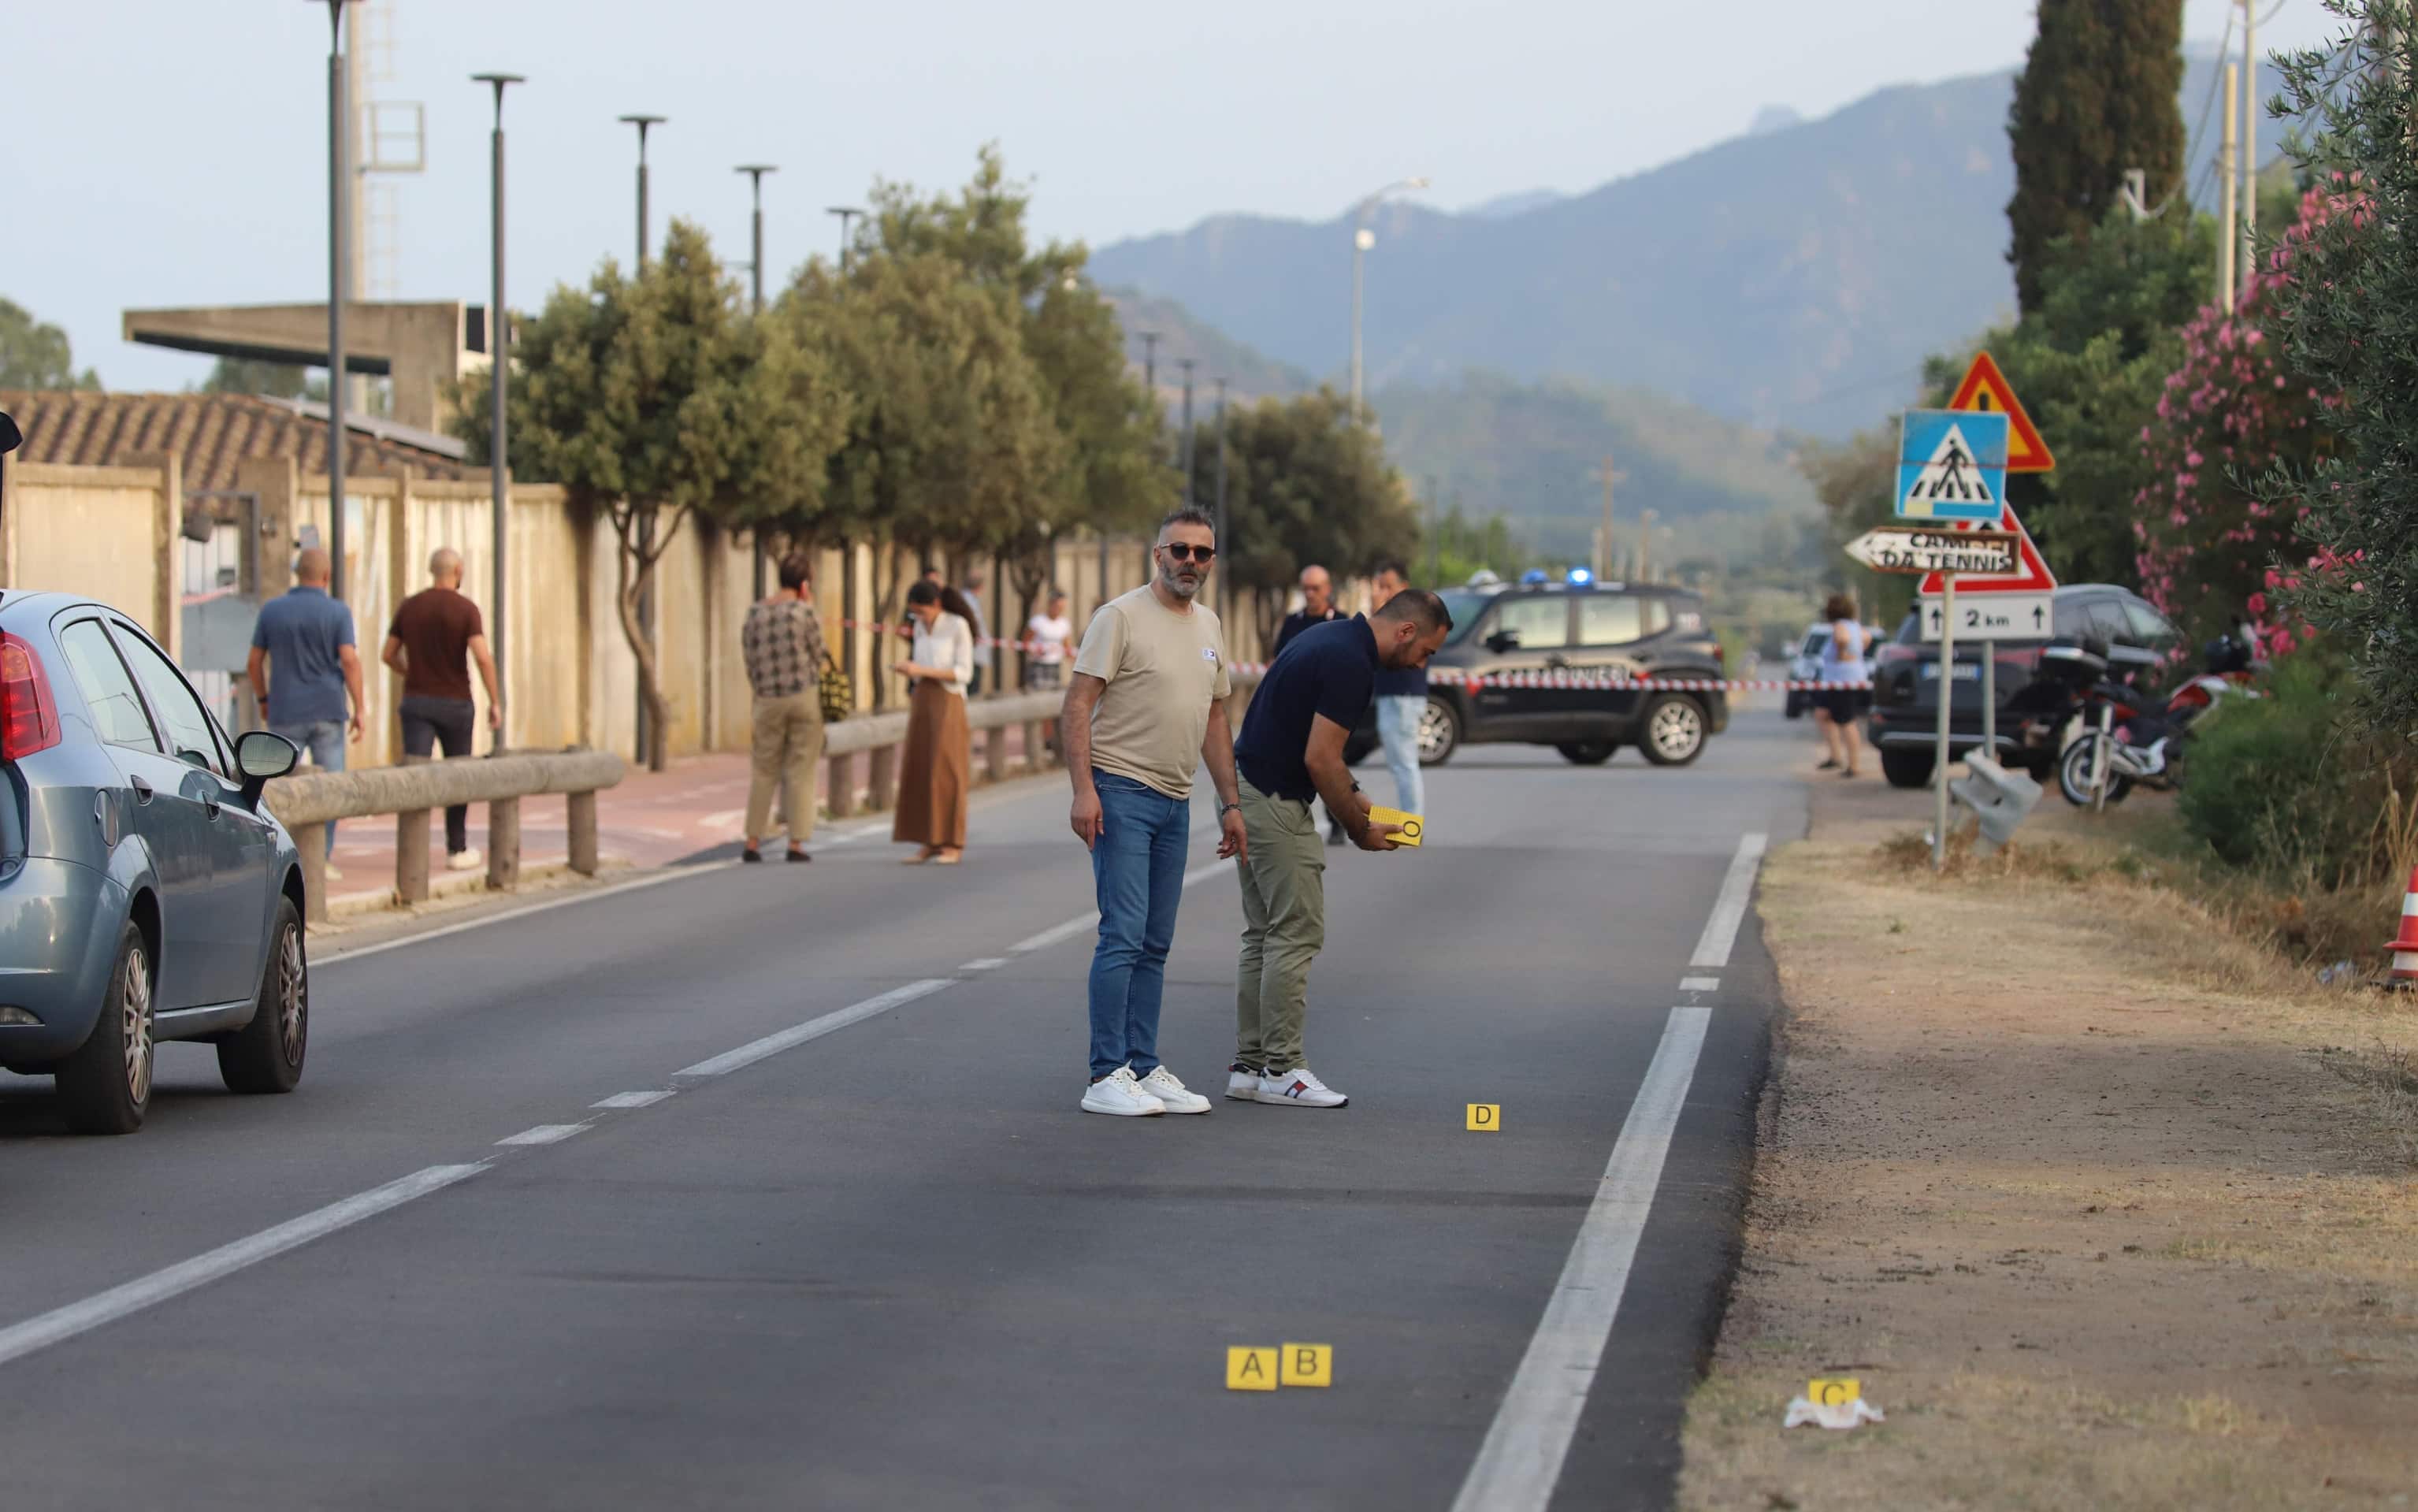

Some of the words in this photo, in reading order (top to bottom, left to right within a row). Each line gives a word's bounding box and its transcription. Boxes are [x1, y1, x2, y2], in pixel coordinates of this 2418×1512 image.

[1880, 551, 1915, 568] DA
[1926, 553, 2012, 571] TENNIS
[1966, 609, 1979, 627] 2
[1985, 615, 2009, 626] km
[1476, 1105, 1491, 1124] D
[1240, 1351, 1265, 1380] A
[1296, 1348, 1318, 1375] B
[1822, 1383, 1846, 1406] C
